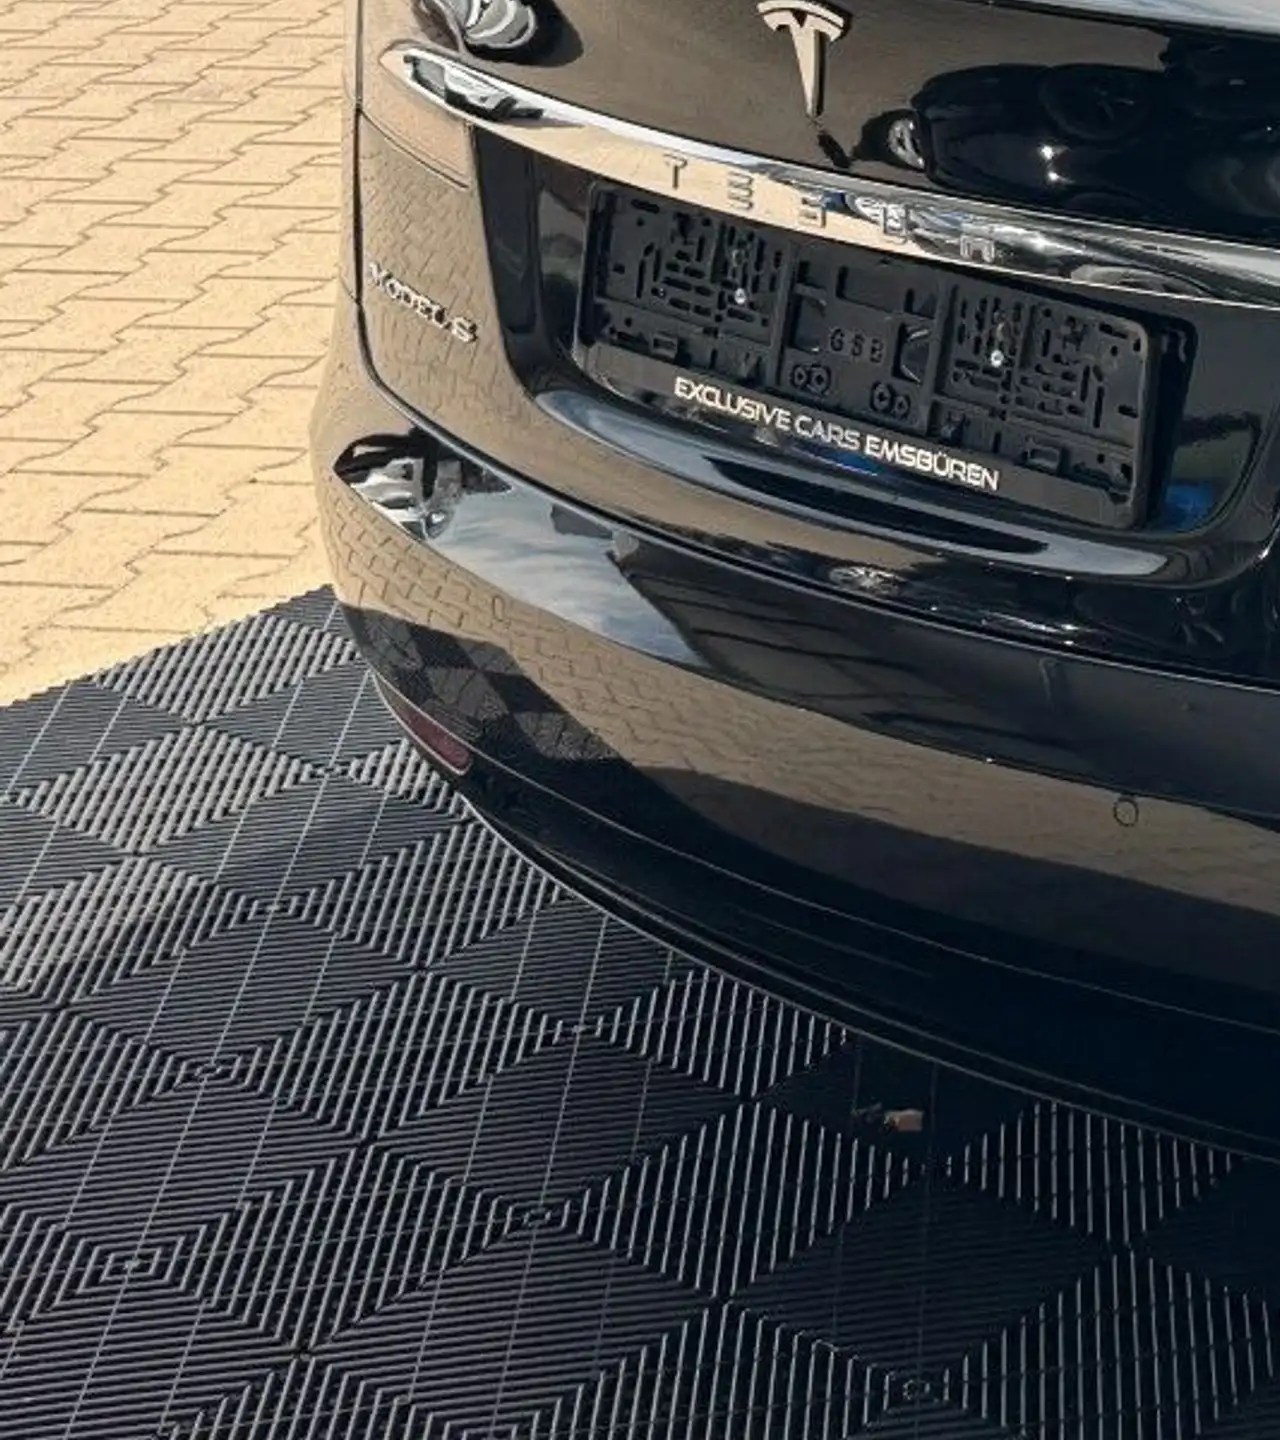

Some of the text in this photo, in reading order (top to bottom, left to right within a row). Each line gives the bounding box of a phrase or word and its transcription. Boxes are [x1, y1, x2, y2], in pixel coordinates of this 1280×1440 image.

[664, 154, 996, 263] TESLA
[368, 261, 477, 342] MODEL S
[673, 375, 999, 491] EXCLUSIVE CARS EMSBÜREN
